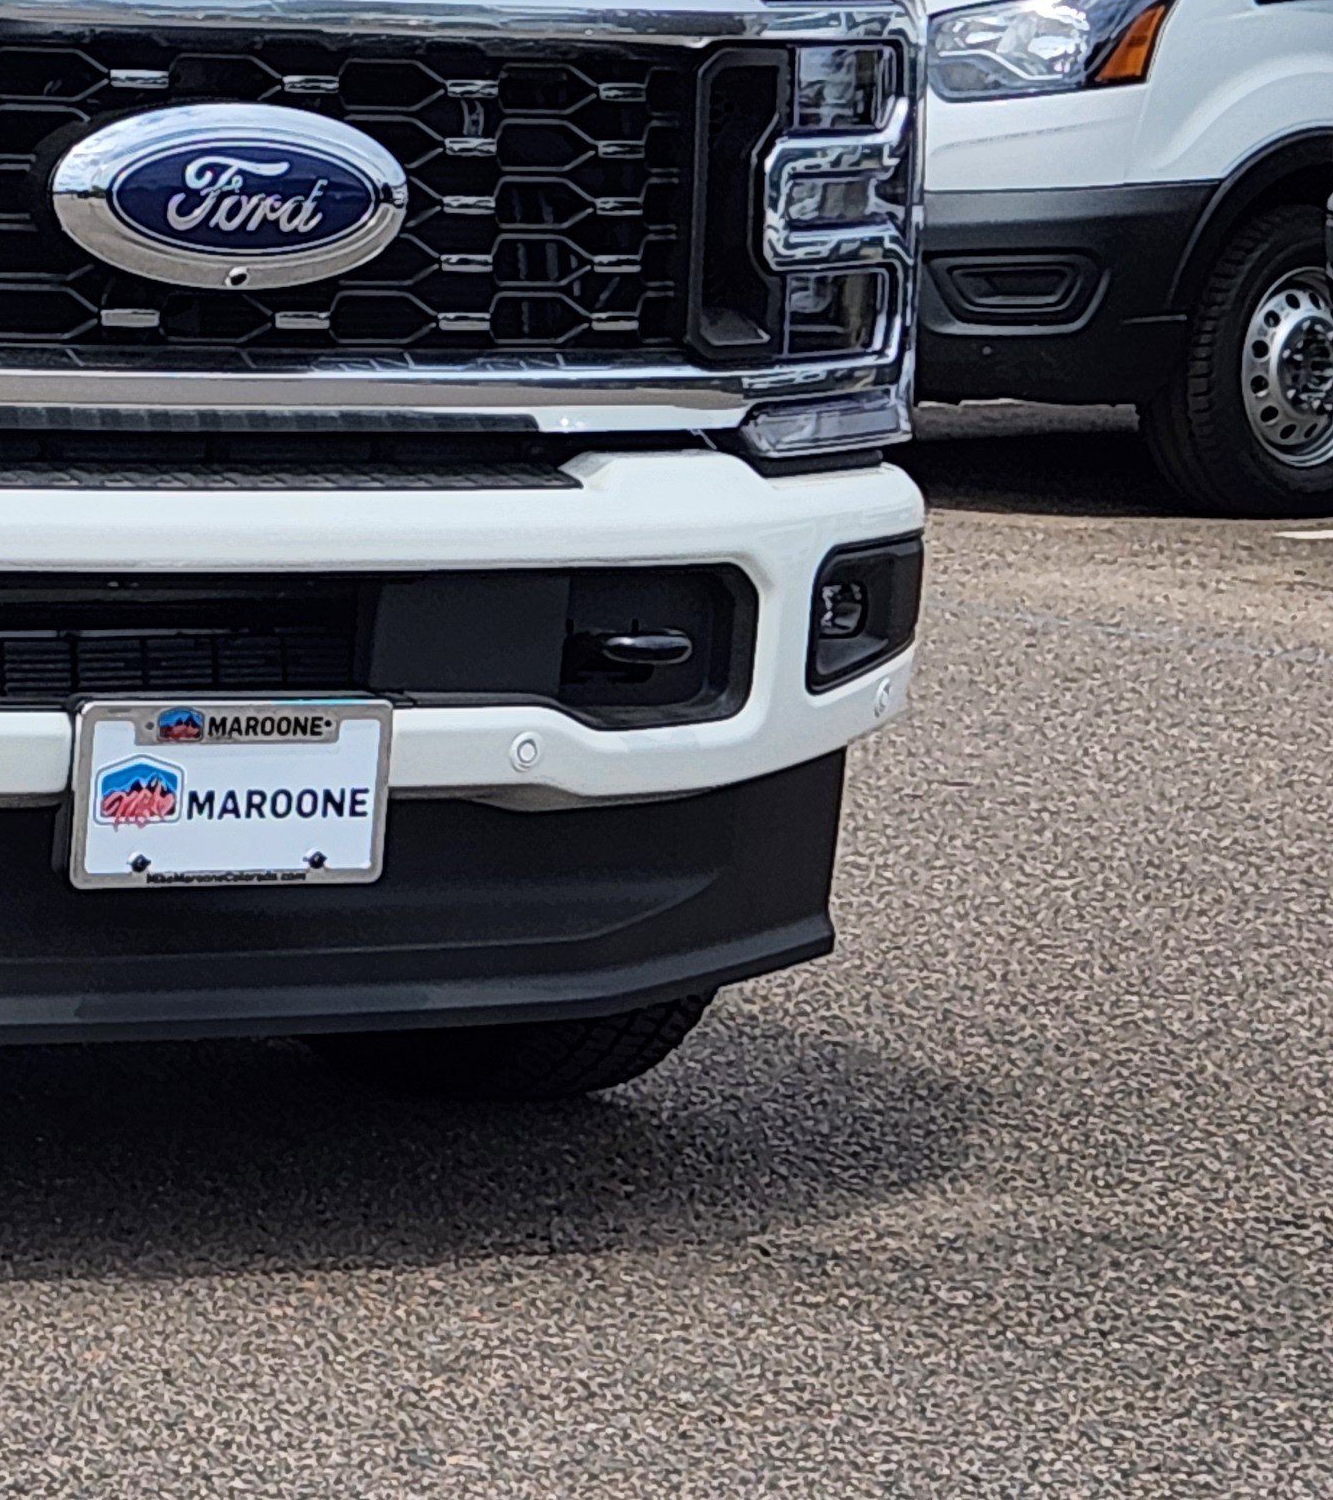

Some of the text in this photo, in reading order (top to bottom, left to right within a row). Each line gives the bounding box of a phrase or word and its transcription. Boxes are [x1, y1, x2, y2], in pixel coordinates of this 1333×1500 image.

[166, 155, 328, 233] Ford
[208, 716, 324, 737] MAROONE
[186, 787, 371, 820] MAROONE
